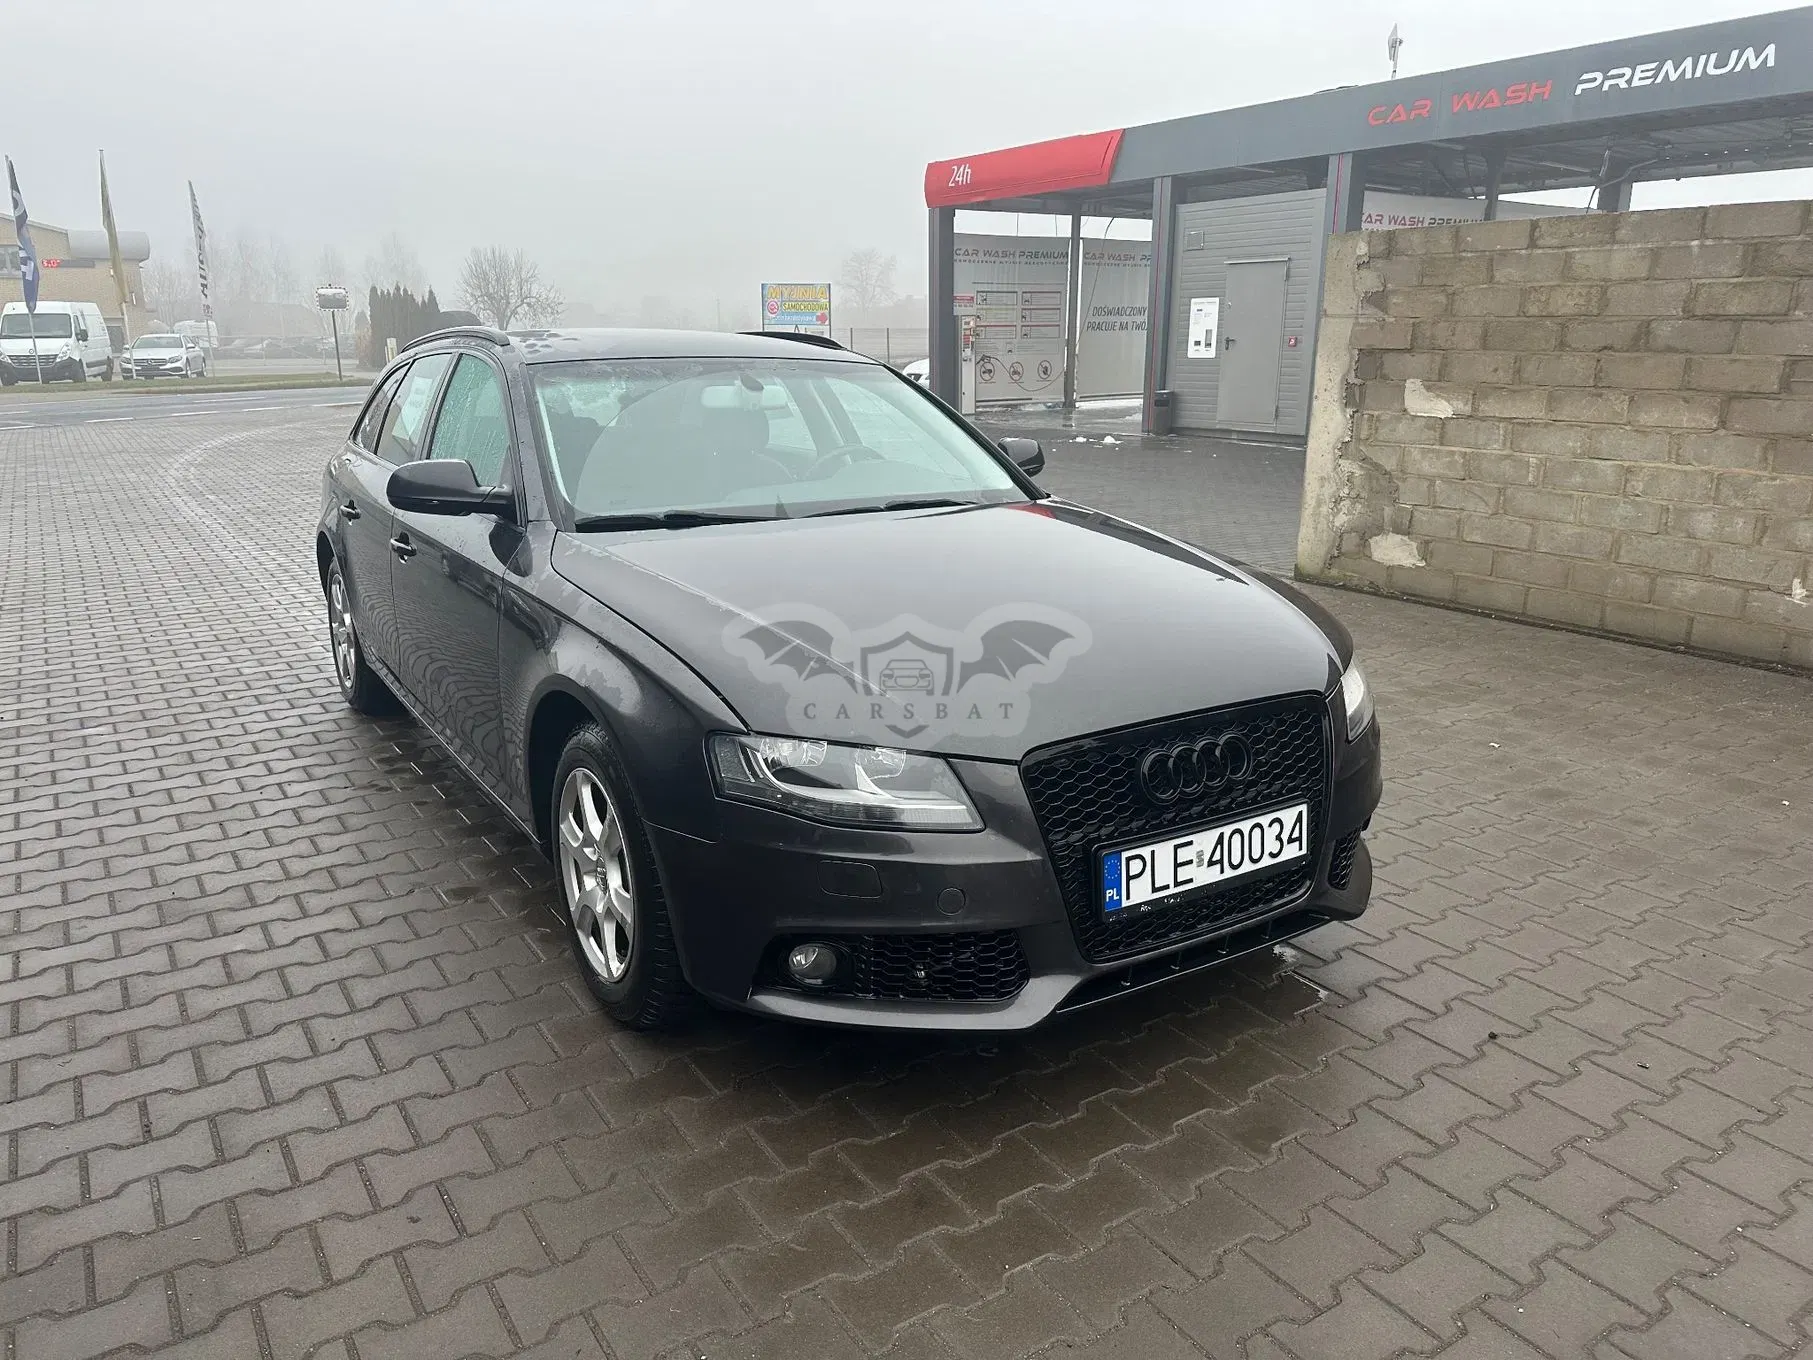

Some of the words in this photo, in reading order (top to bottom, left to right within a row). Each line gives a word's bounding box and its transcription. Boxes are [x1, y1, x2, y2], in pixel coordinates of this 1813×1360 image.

[1368, 98, 1433, 127] CAR
[1452, 79, 1553, 113] WASH
[1574, 43, 1776, 96] PREMIUM
[948, 163, 972, 187] 24h
[1361, 213, 1384, 225] AR
[1387, 215, 1426, 227] WASH
[954, 247, 980, 257] CAR
[983, 249, 1017, 259] WASH
[1018, 250, 1069, 260] PREMIUM
[1083, 251, 1105, 261] CAR
[1107, 252, 1137, 262] WASH
[767, 285, 827, 300] MYJNIA
[1092, 304, 1148, 317] DOŚWIADCZONY
[1086, 320, 1118, 332] PRACUJE
[1118, 320, 1129, 331] NA
[1125, 840, 1194, 901] PLE
[1207, 810, 1303, 875] 40034
[1105, 888, 1120, 903] PL
